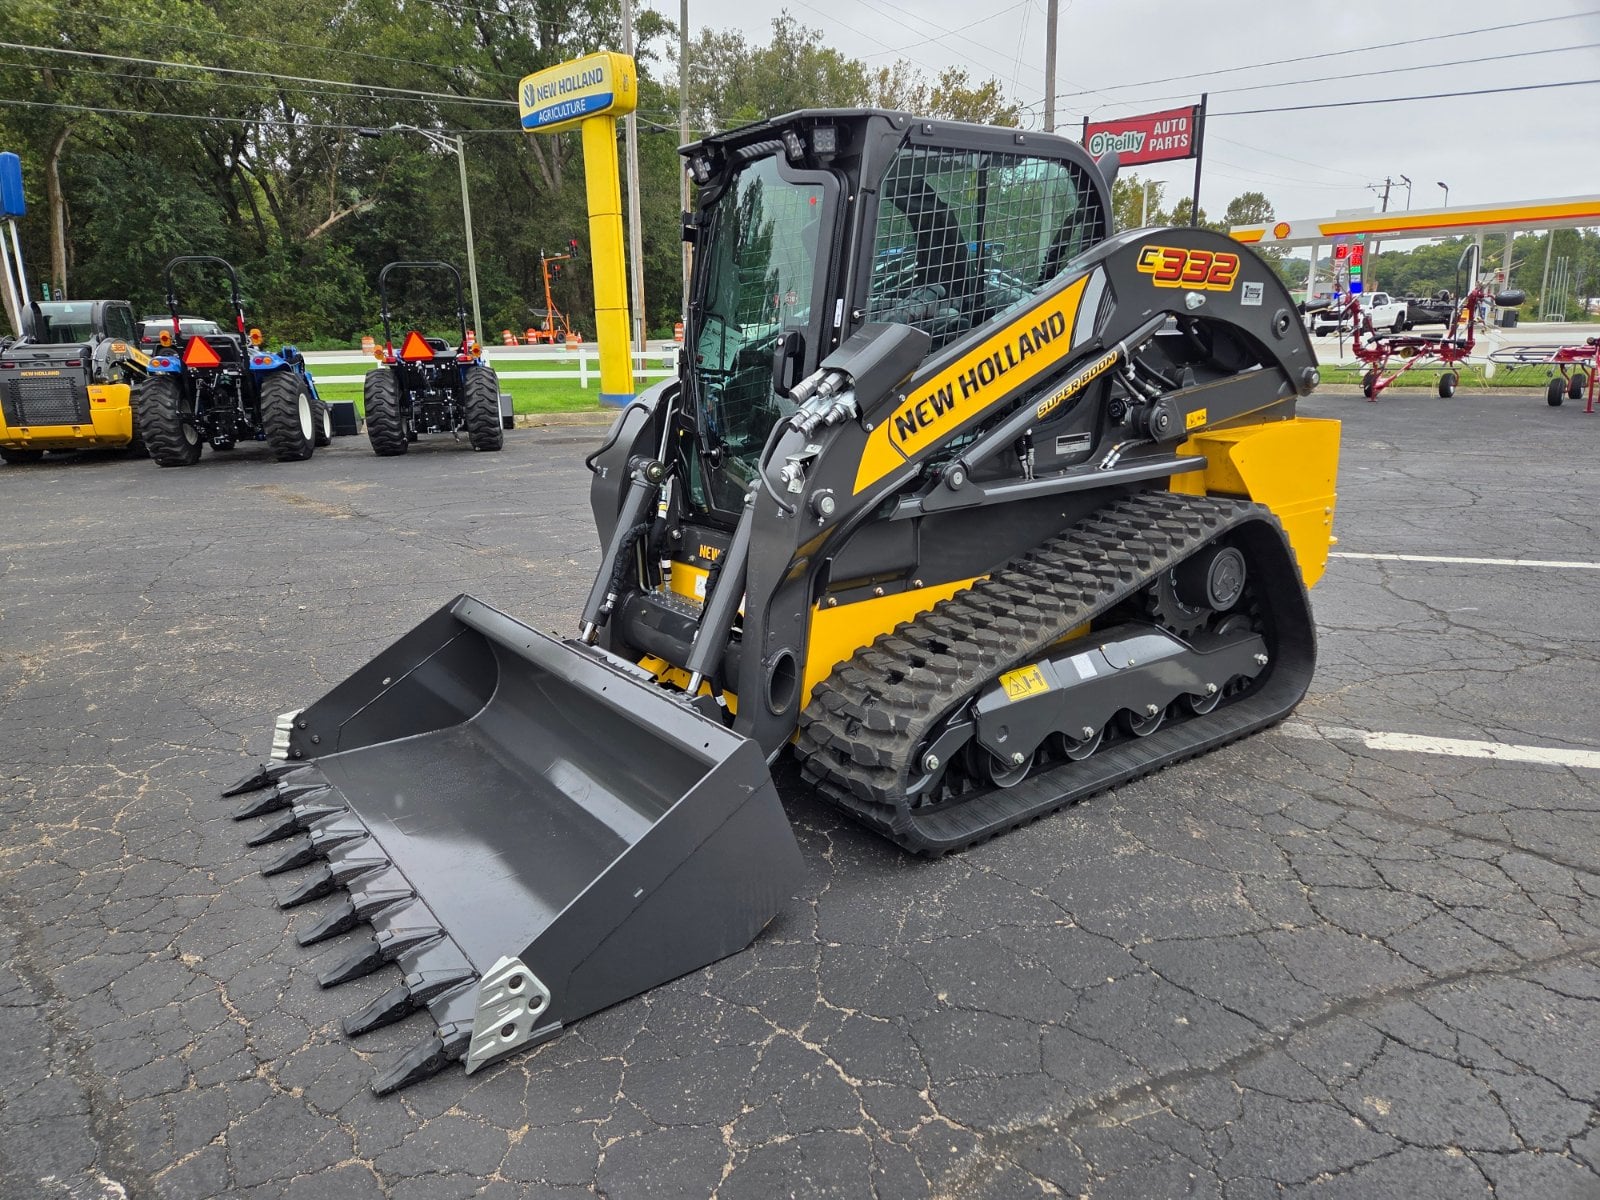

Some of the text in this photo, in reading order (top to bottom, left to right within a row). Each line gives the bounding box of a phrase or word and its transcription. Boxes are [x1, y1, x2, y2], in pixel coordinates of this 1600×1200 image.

[537, 67, 603, 101] NEW HOLLAND
[538, 99, 586, 123] AGRICULTURE
[1153, 117, 1187, 135] AUTO
[1149, 133, 1189, 151] PARTS
[894, 310, 1066, 442] NEW HOLLAND
[1037, 351, 1117, 418] SUPER BOOM
